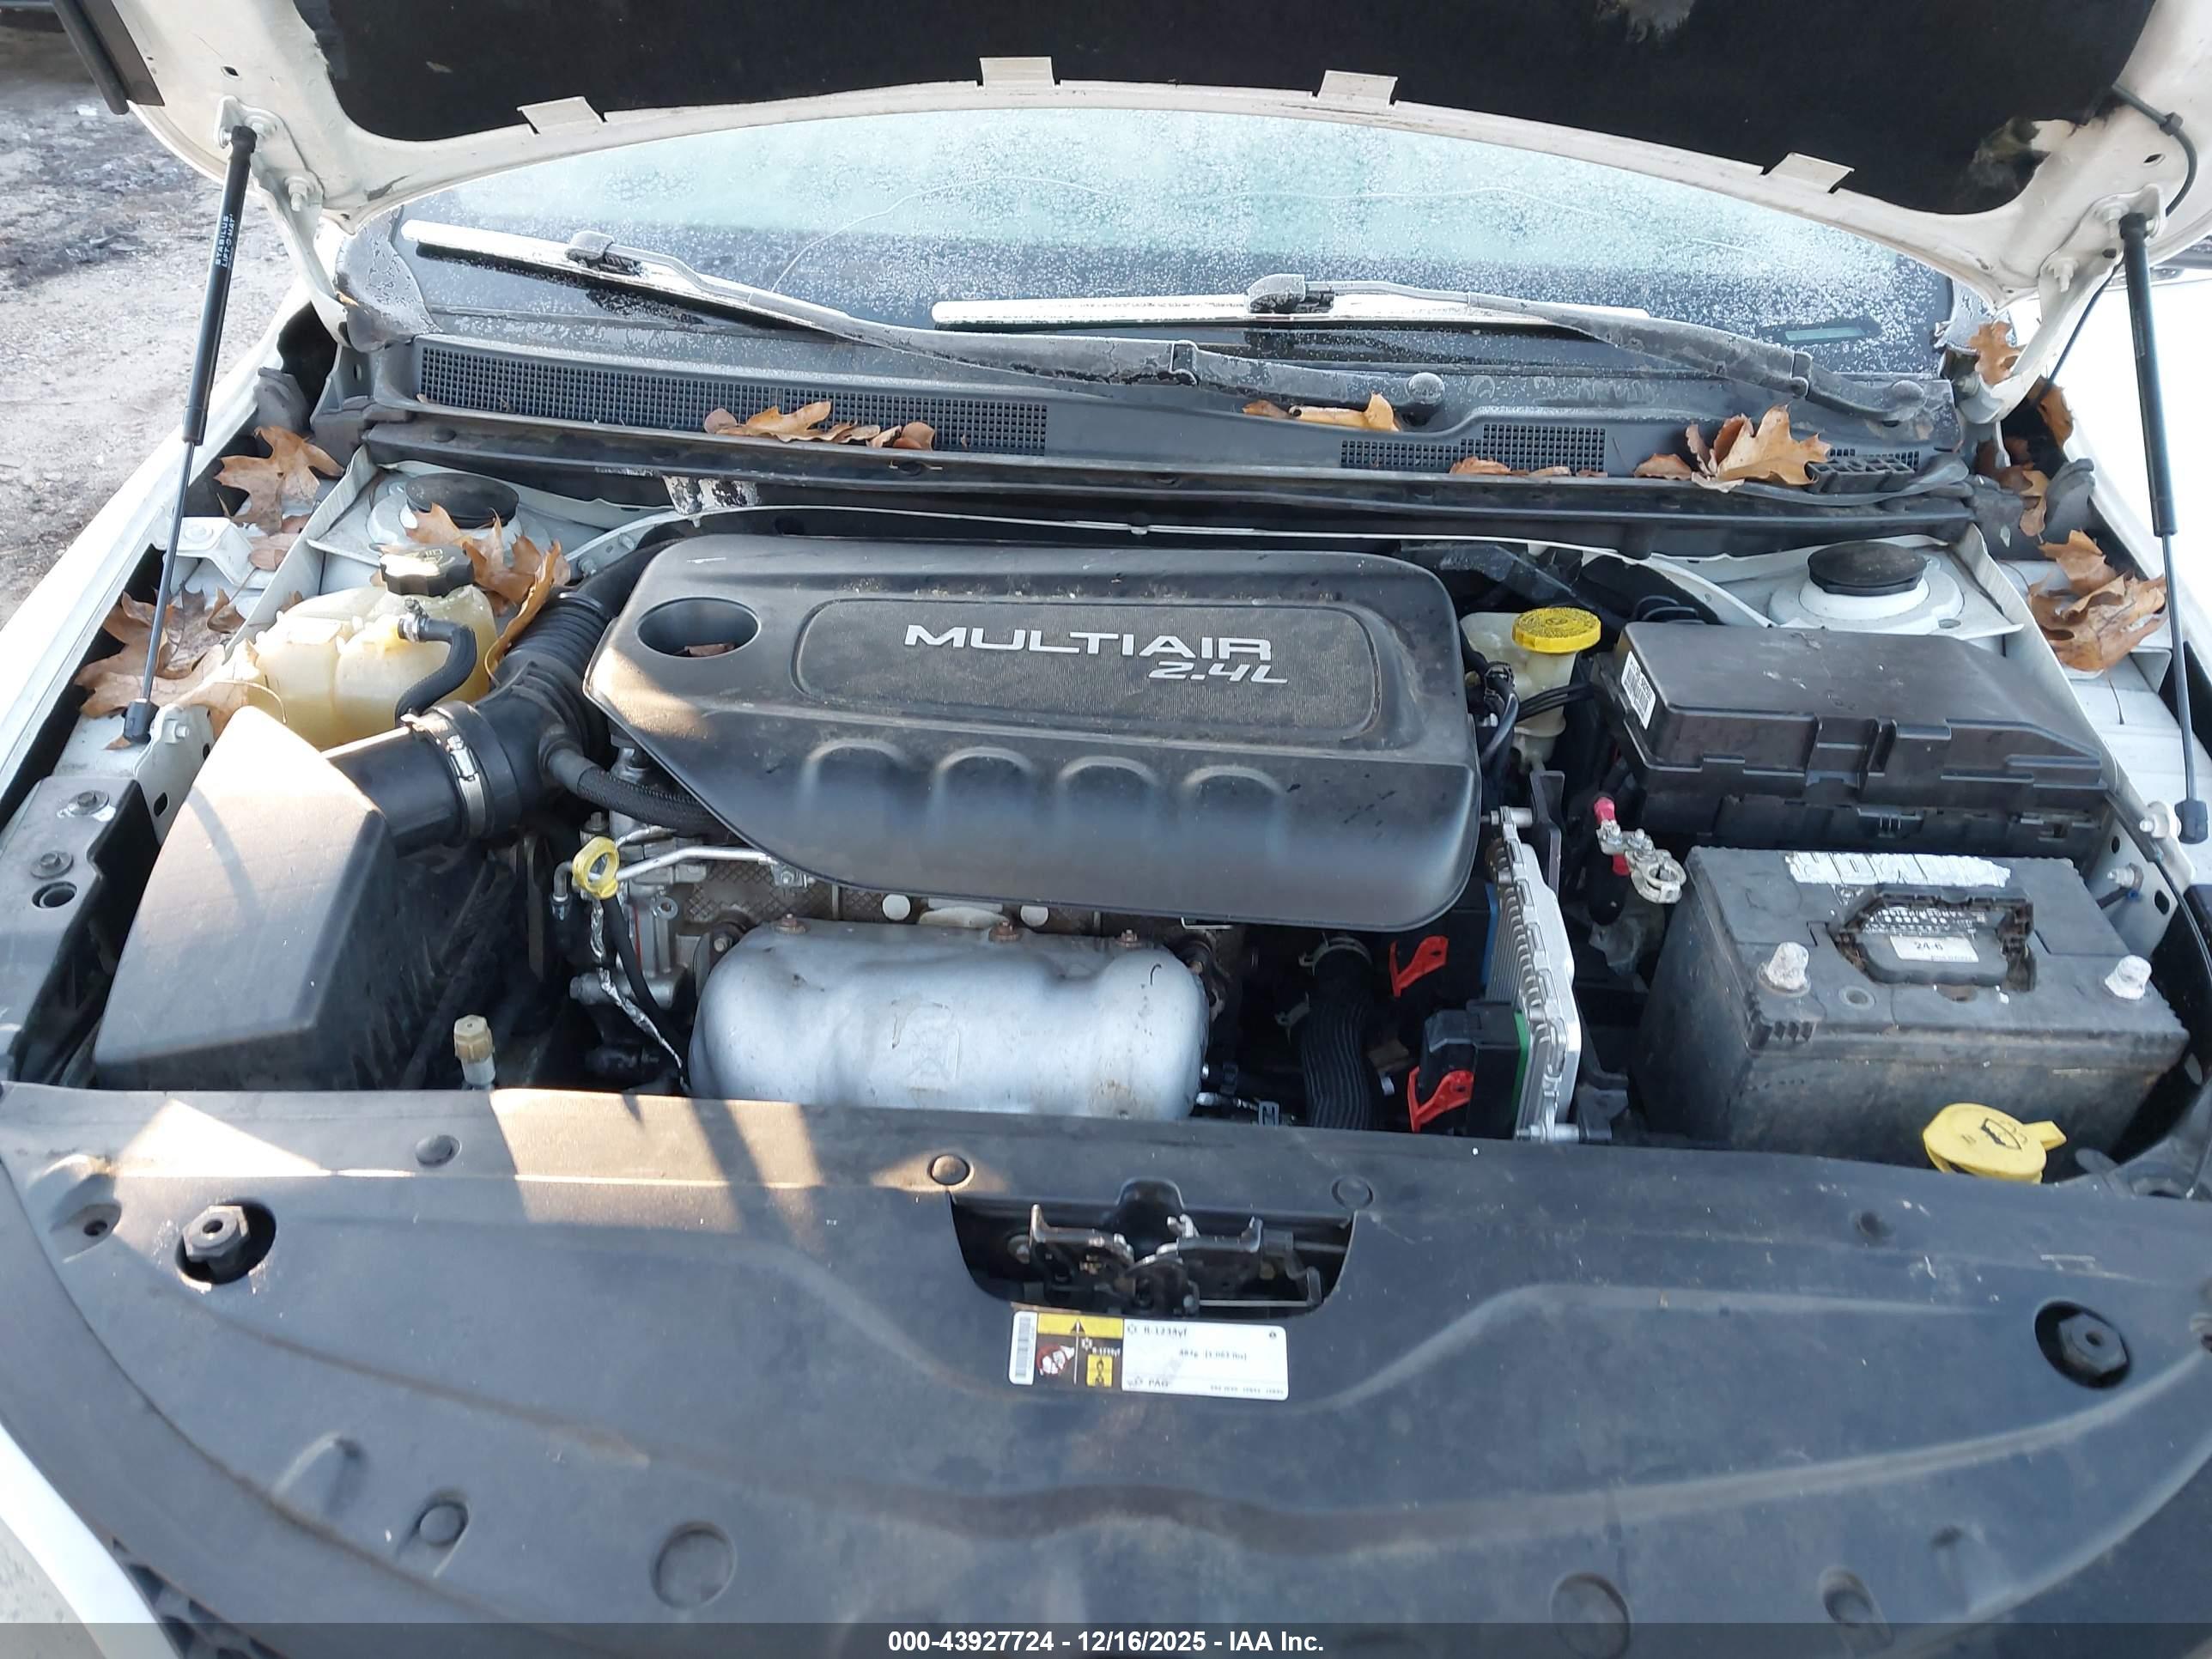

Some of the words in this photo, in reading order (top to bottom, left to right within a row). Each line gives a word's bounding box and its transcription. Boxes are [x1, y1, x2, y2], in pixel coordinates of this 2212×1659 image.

[215, 215, 229, 266] STABILUS
[903, 623, 1274, 661] MULTIAIR
[1148, 660, 1289, 684] 2.4L
